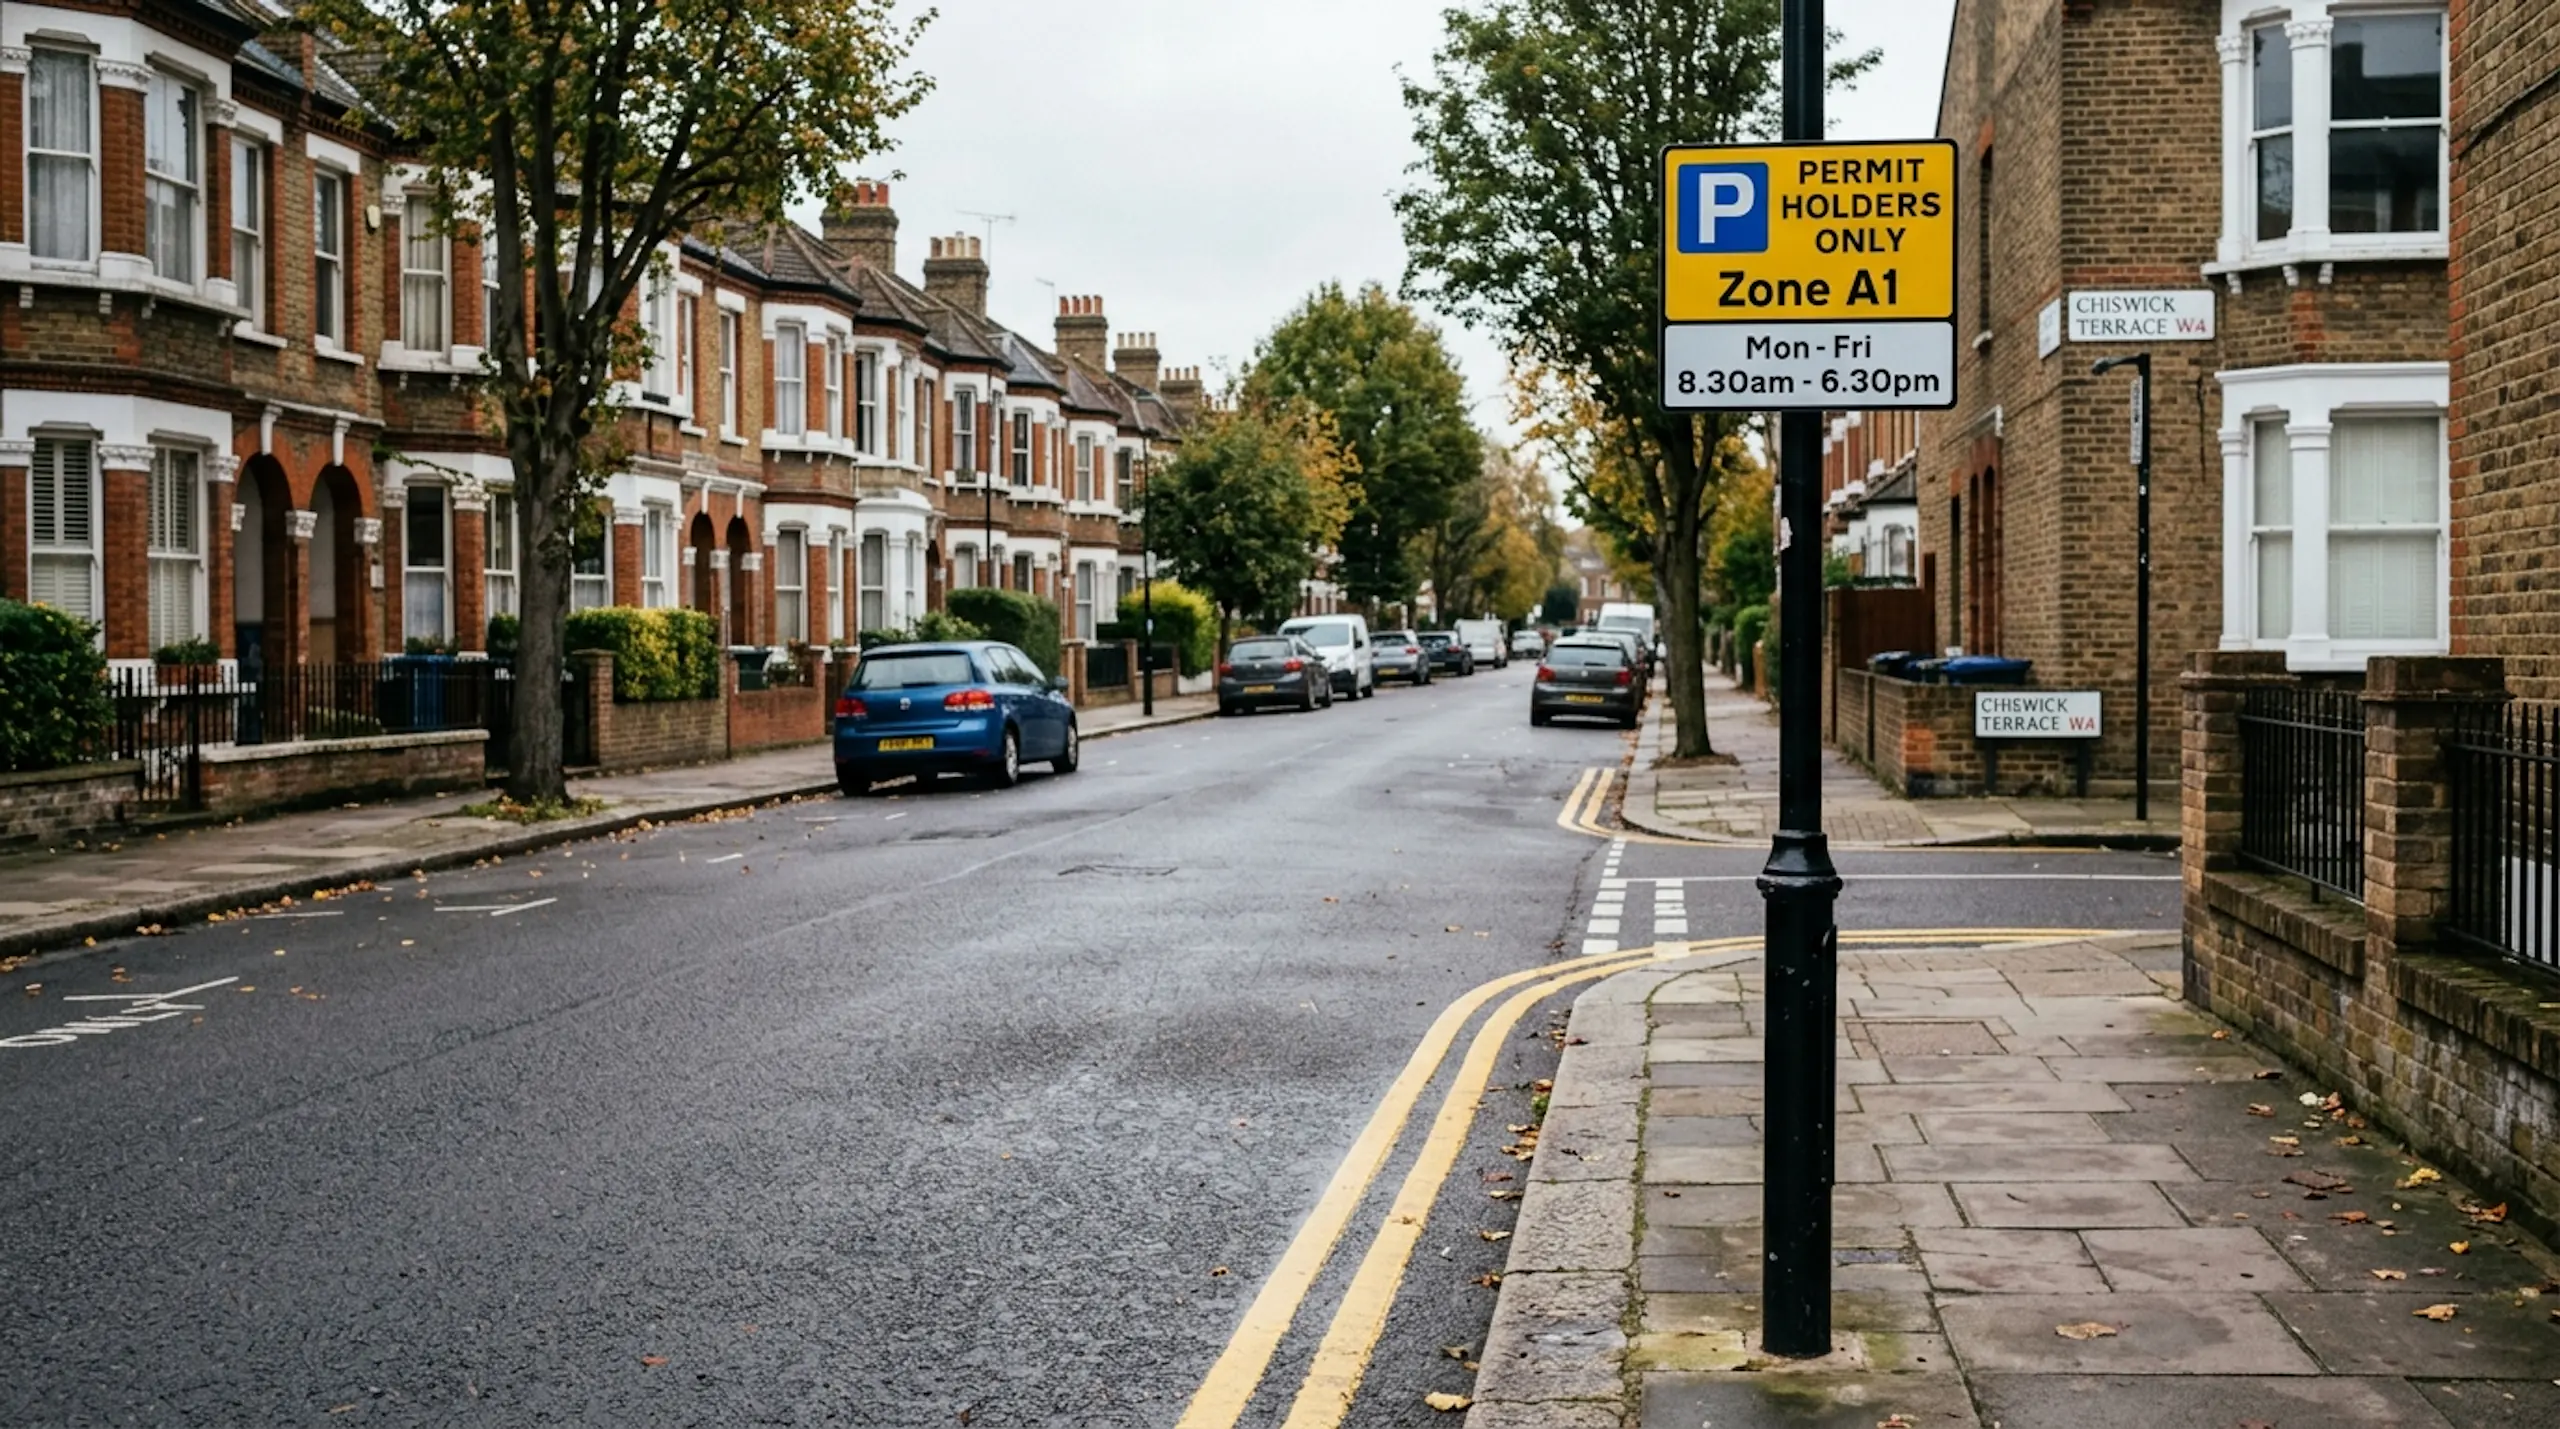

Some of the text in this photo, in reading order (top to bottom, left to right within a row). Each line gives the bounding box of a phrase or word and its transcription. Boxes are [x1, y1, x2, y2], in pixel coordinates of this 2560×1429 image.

[1799, 158, 1925, 184] PERMIT
[1698, 172, 1755, 244] P
[1782, 192, 1941, 219] HOLDERS
[1815, 227, 1906, 253] ONLY
[1719, 268, 1897, 307] Zone A1
[2076, 296, 2176, 314] CHISWICK
[2076, 318, 2167, 335] TERRACE
[1746, 335, 1810, 360] Mon
[1834, 334, 1871, 358] Fri
[1678, 369, 1795, 394] 8.30am
[1821, 368, 1940, 397] 6.30pm
[1981, 716, 2061, 731] TERRACE
